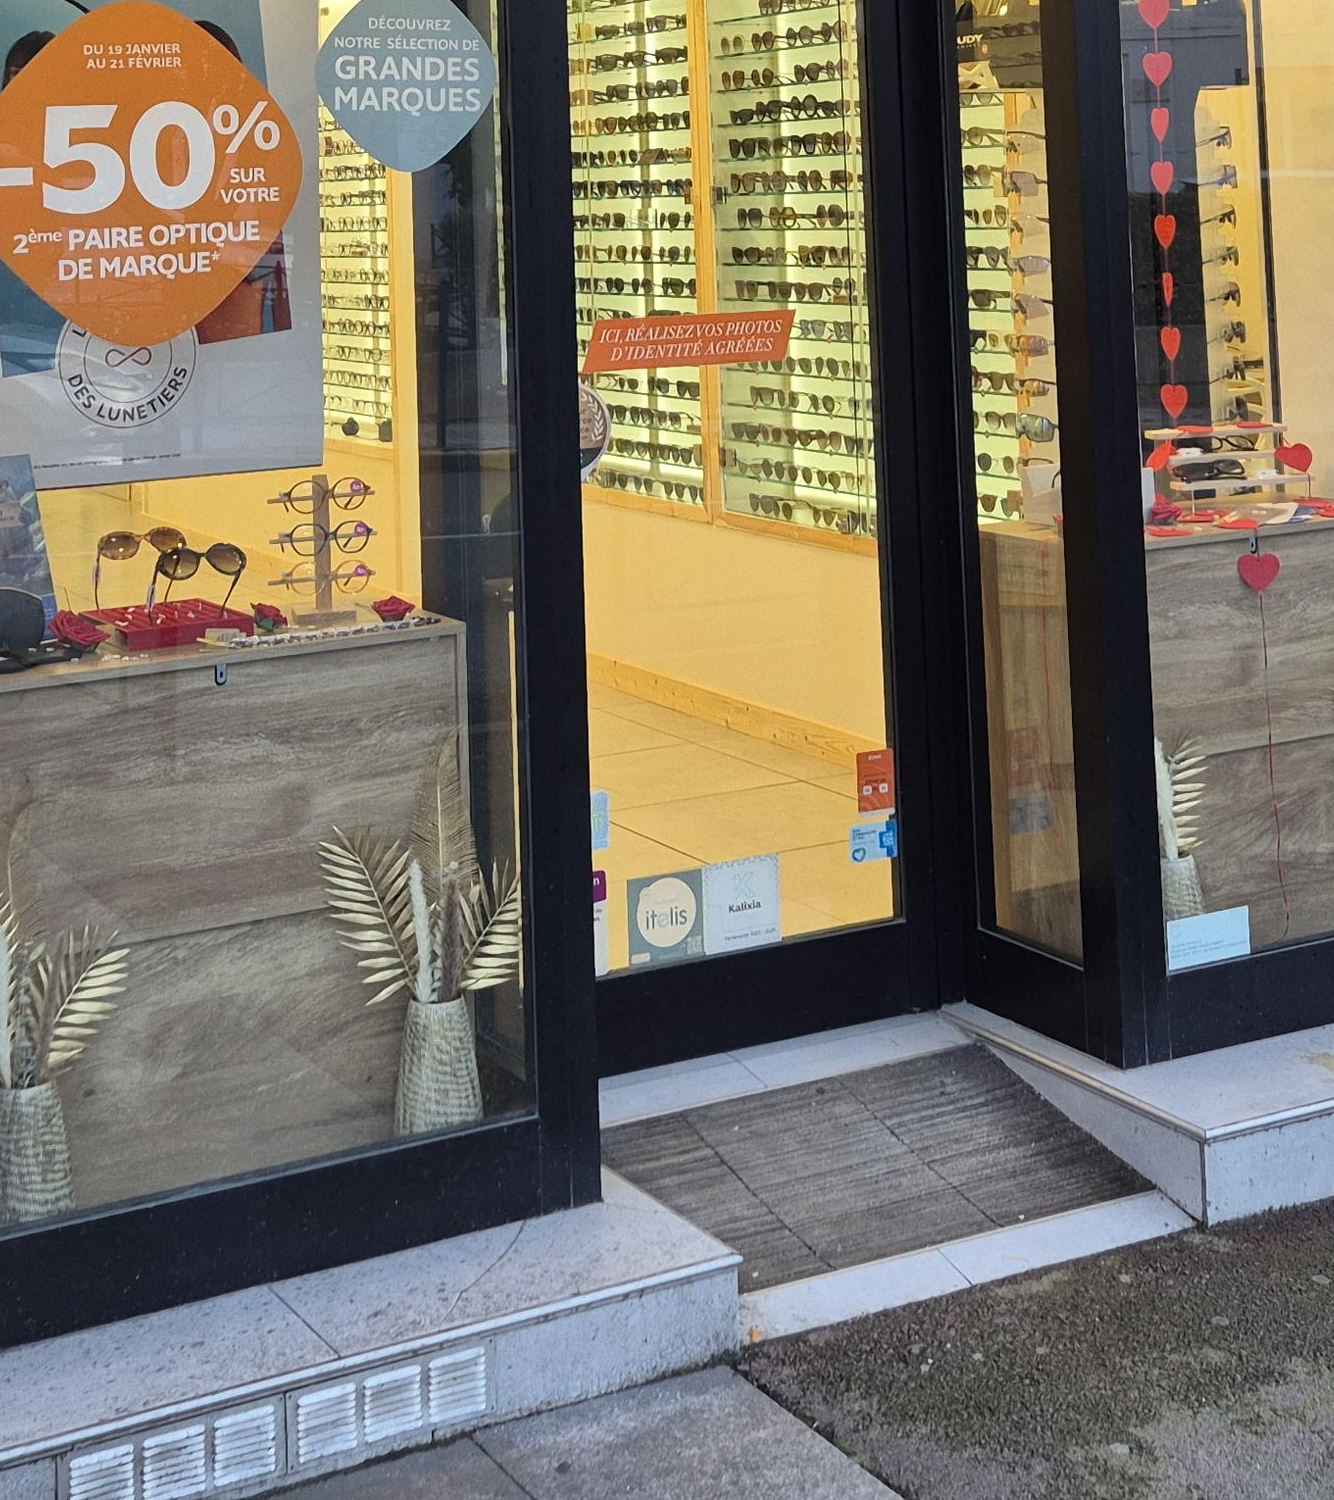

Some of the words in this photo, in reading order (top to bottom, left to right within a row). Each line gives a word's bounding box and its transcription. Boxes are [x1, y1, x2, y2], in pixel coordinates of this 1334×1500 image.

[368, 14, 451, 31] DÉCOUVREZ
[334, 36, 381, 49] NOTRE
[387, 34, 459, 51] SÉLECTION
[463, 39, 480, 51] DE
[956, 33, 983, 45] UDY
[83, 44, 103, 56] DU
[107, 45, 123, 55] 19
[125, 43, 182, 55] JANVIER
[86, 58, 106, 69] AU
[109, 58, 125, 69] 21
[128, 54, 182, 69] FÉVRIER
[334, 55, 480, 82] GRANDES
[334, 86, 482, 116] MARQUES
[229, 167, 266, 183] SUR
[220, 187, 280, 204] VOTRE
[12, 228, 63, 254] 2ème
[68, 226, 143, 251] PAIRE
[149, 219, 260, 247] OPTIQUE
[58, 258, 93, 281] DE
[71, 328, 87, 338] L
[598, 327, 623, 344] ICI,
[625, 323, 695, 342] RÉALISEZ
[694, 322, 724, 338] VOS
[725, 318, 783, 336] PHOTOS
[610, 339, 703, 362] D'IDENTITÉ
[704, 335, 774, 356] AGRÉÉES
[67, 373, 96, 410] DES
[96, 366, 188, 423] LUNETIERS
[728, 899, 762, 914] Kalixia
[645, 905, 688, 931] itelis
